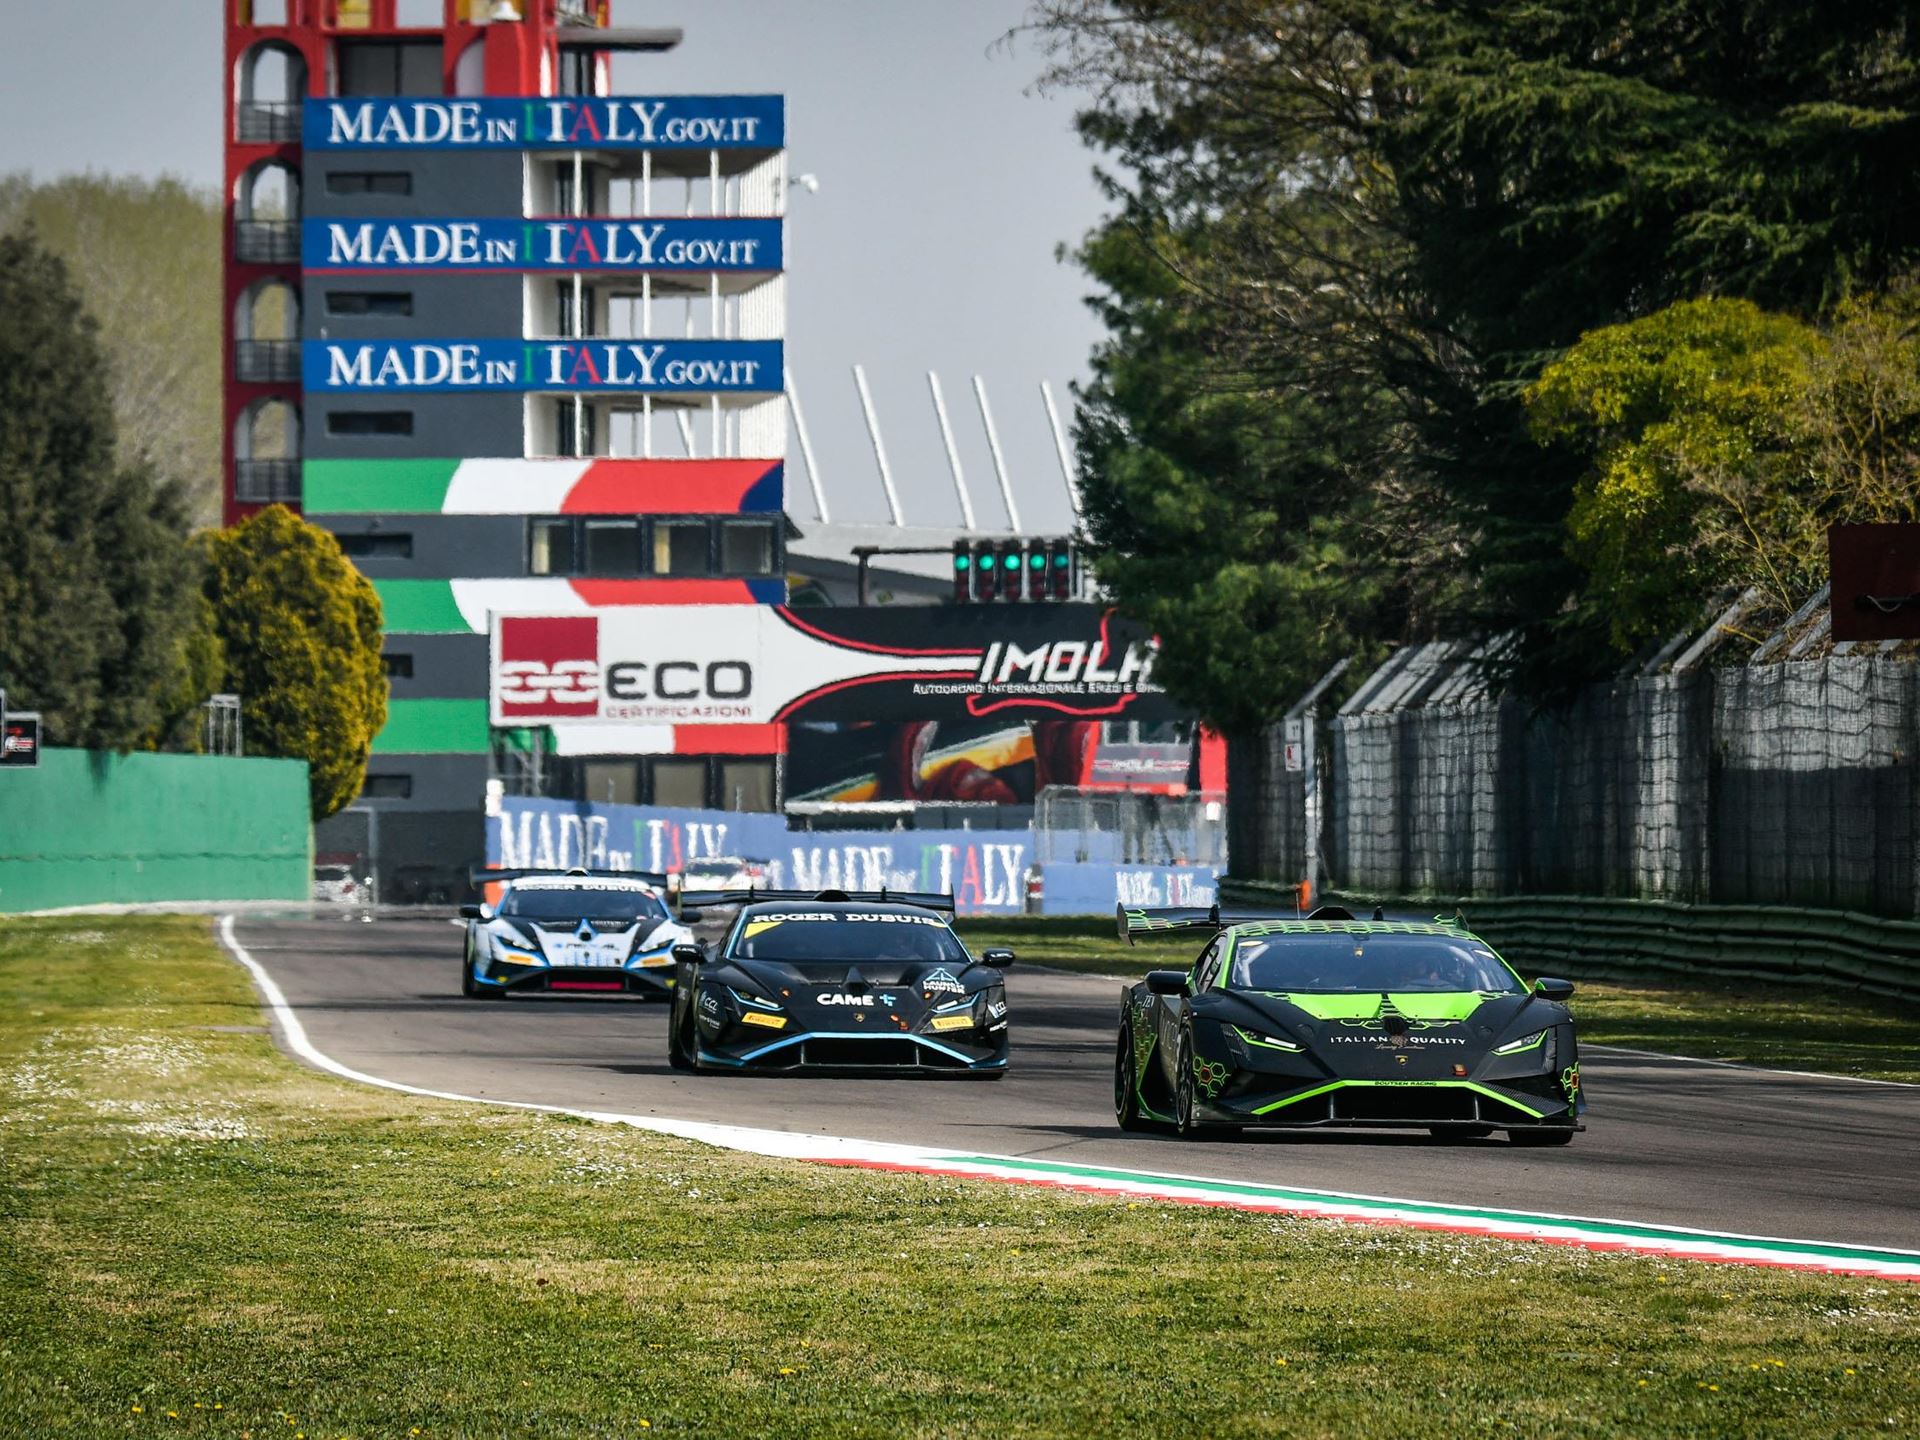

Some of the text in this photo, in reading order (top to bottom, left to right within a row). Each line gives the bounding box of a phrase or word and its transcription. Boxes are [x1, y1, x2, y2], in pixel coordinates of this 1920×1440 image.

[606, 661, 752, 700] ECO
[912, 682, 985, 695] AUTODROMO
[987, 682, 1085, 694] INTERNAZIONALE
[606, 704, 752, 719] CERTIFICAZIONI
[752, 913, 837, 923] ROGER
[816, 993, 874, 1006] CAME
[1409, 1036, 1466, 1045] QUALITY
